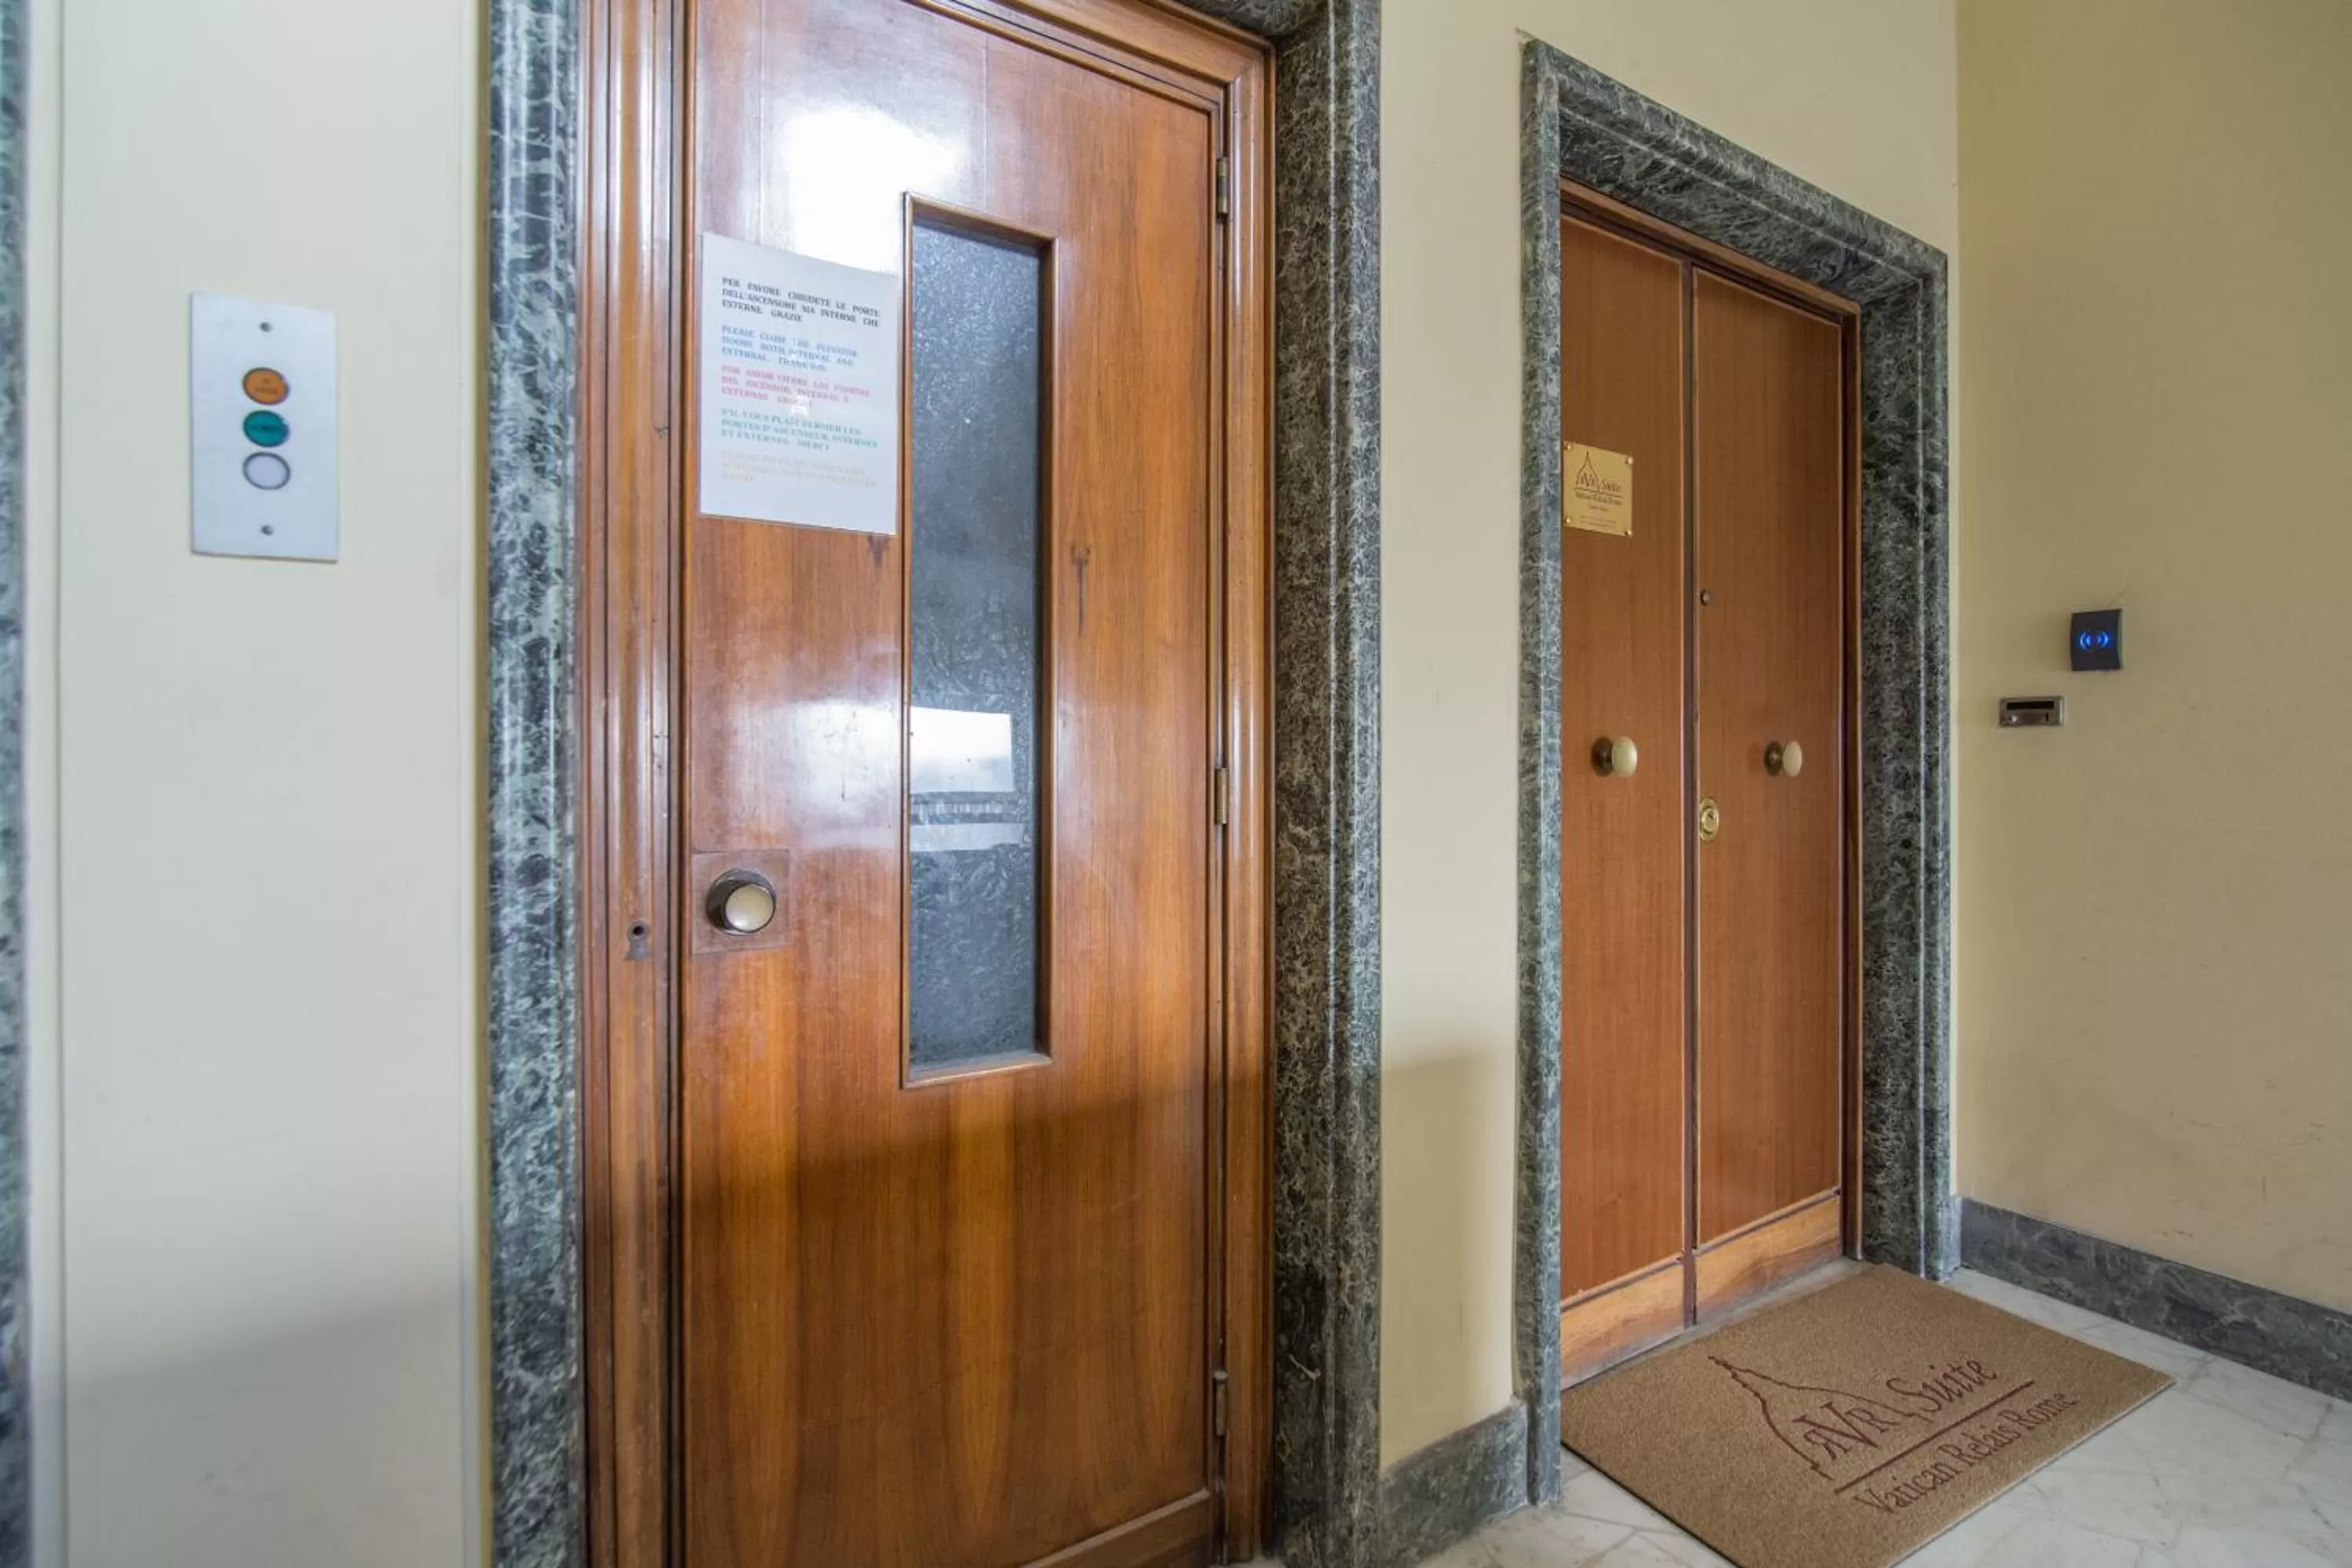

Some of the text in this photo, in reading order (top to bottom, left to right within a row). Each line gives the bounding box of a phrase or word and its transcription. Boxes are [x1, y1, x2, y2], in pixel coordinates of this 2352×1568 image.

[1886, 1360, 1998, 1412] Suite
[1852, 1393, 2079, 1514] Vatican Relais Rome
